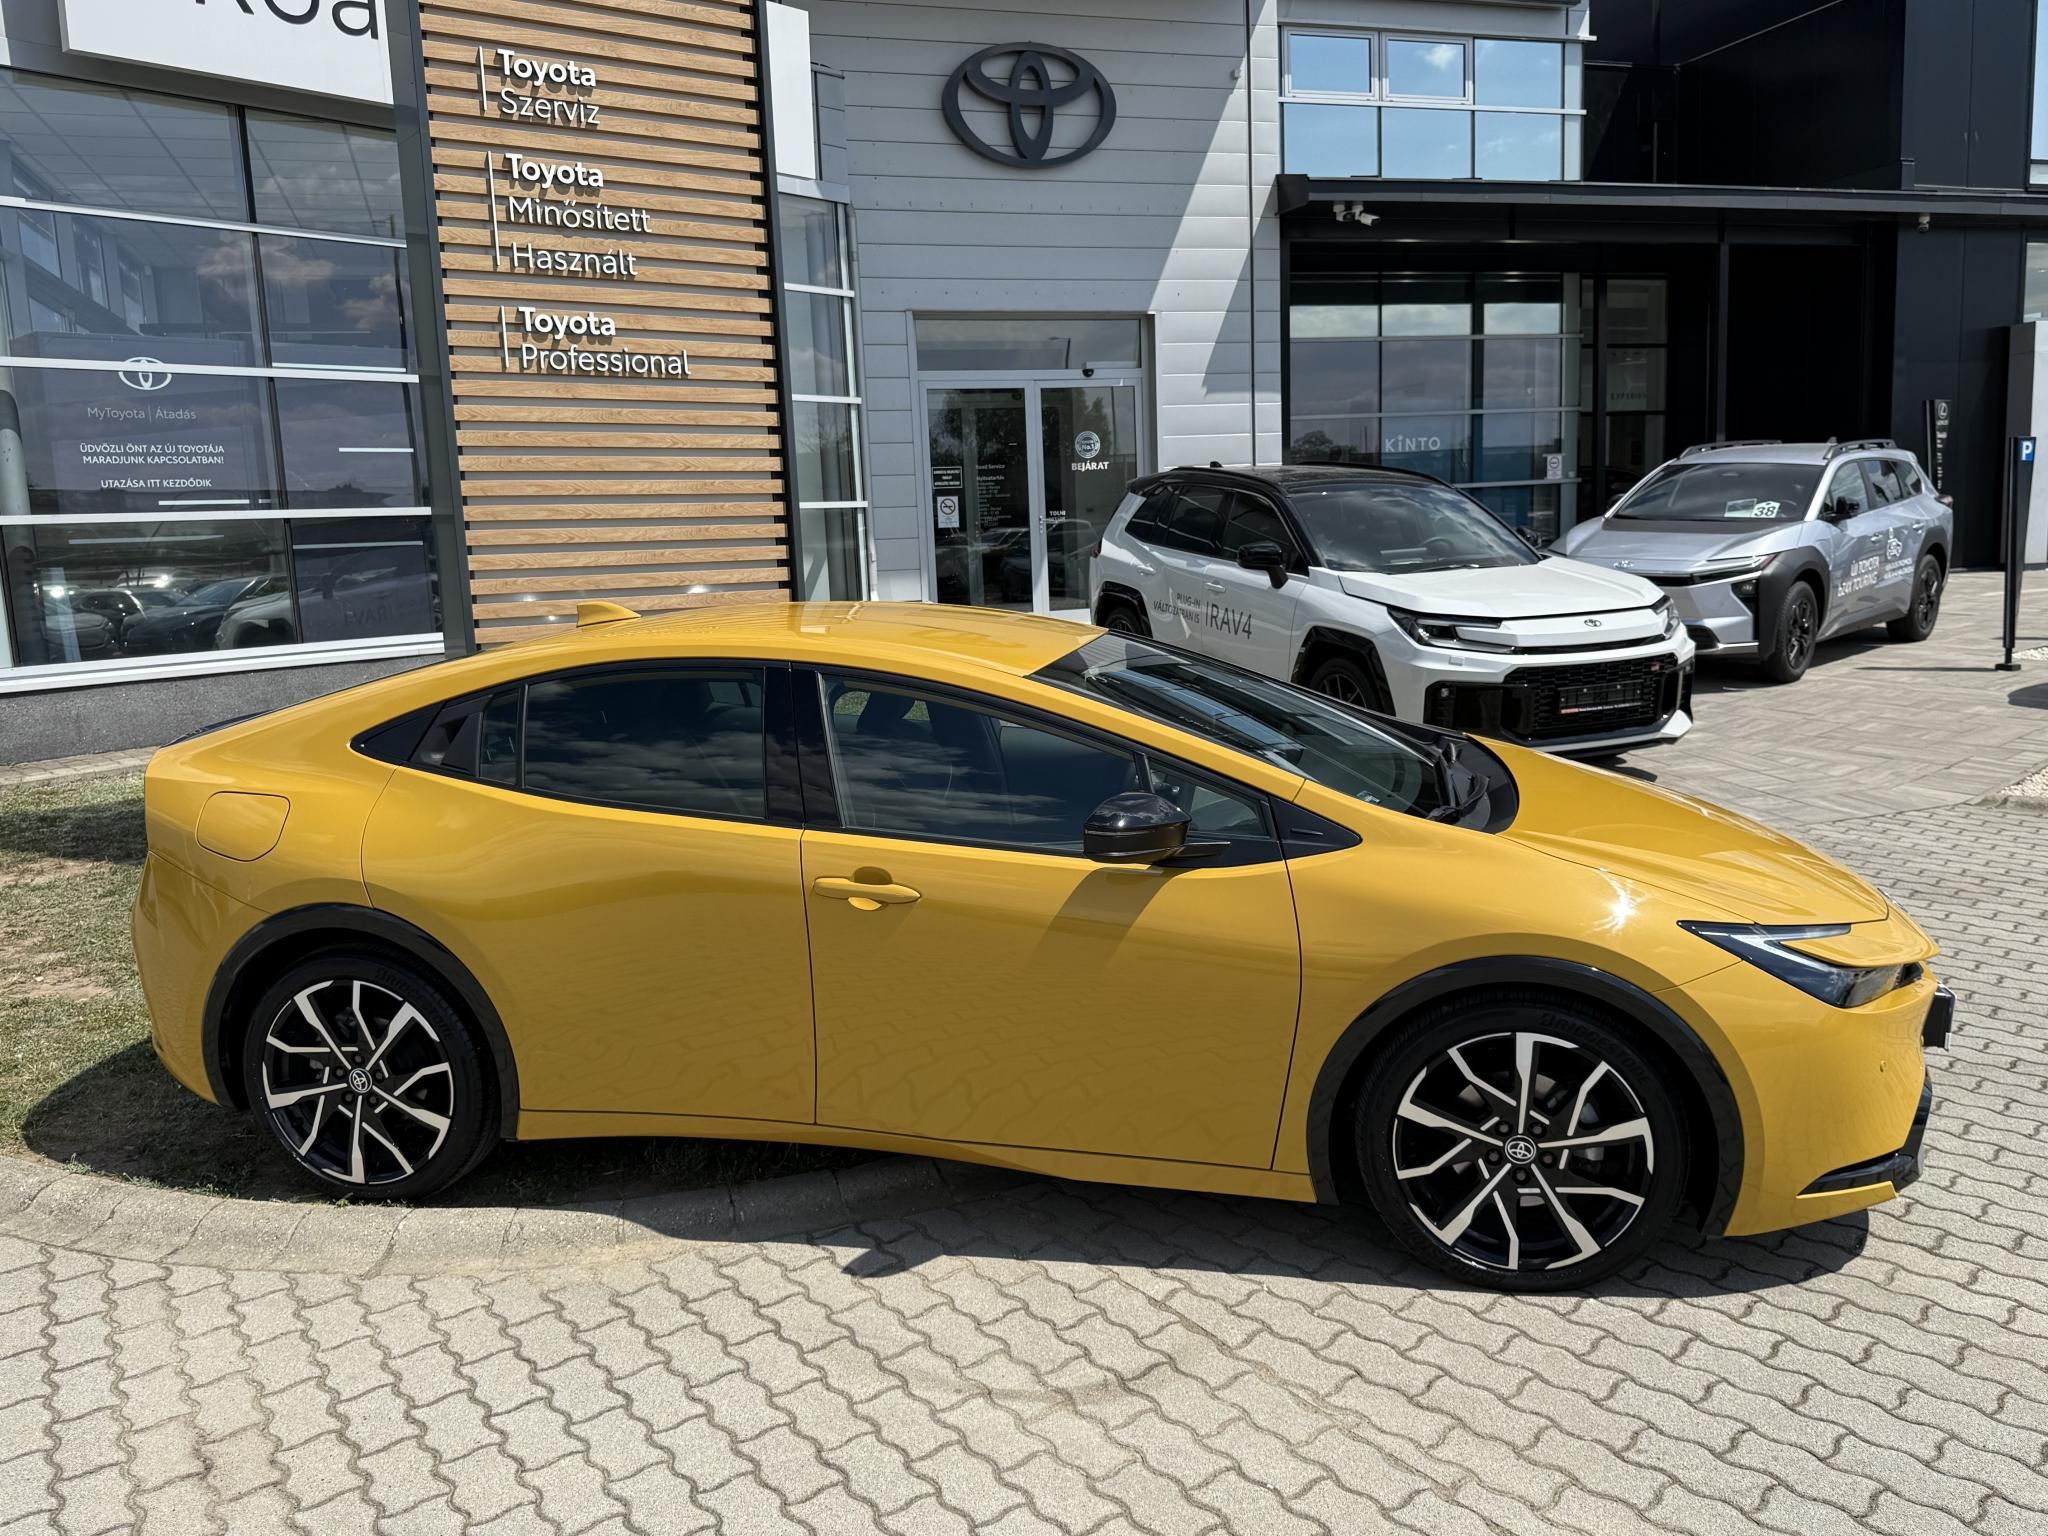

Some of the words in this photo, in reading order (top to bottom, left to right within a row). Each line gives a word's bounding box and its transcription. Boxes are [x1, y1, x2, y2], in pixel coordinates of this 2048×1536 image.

[497, 48, 597, 88] Toyota
[500, 87, 601, 125] Szerviz
[505, 152, 604, 188] Toyota
[508, 195, 652, 233] Minősített
[512, 241, 638, 276] Használt
[518, 306, 616, 340] Toyota
[521, 343, 691, 375] Professional
[87, 407, 145, 421] MyToyota
[155, 406, 197, 420] Átadás
[80, 443, 124, 453] ÜDVÖZLI
[126, 443, 147, 453] ÖNT
[150, 445, 162, 453] AZ
[165, 443, 176, 453] ÚJ
[177, 443, 224, 453] TOYOTÁJA
[83, 455, 145, 464] MARADJUNK
[147, 455, 225, 464] KAPCSOLATBAN!
[2022, 441, 2033, 461] P
[1071, 460, 1109, 472] BEJÁRAT
[100, 477, 146, 488] UTAZÁSA
[147, 479, 161, 488] ITT
[1754, 506, 1776, 517] 38
